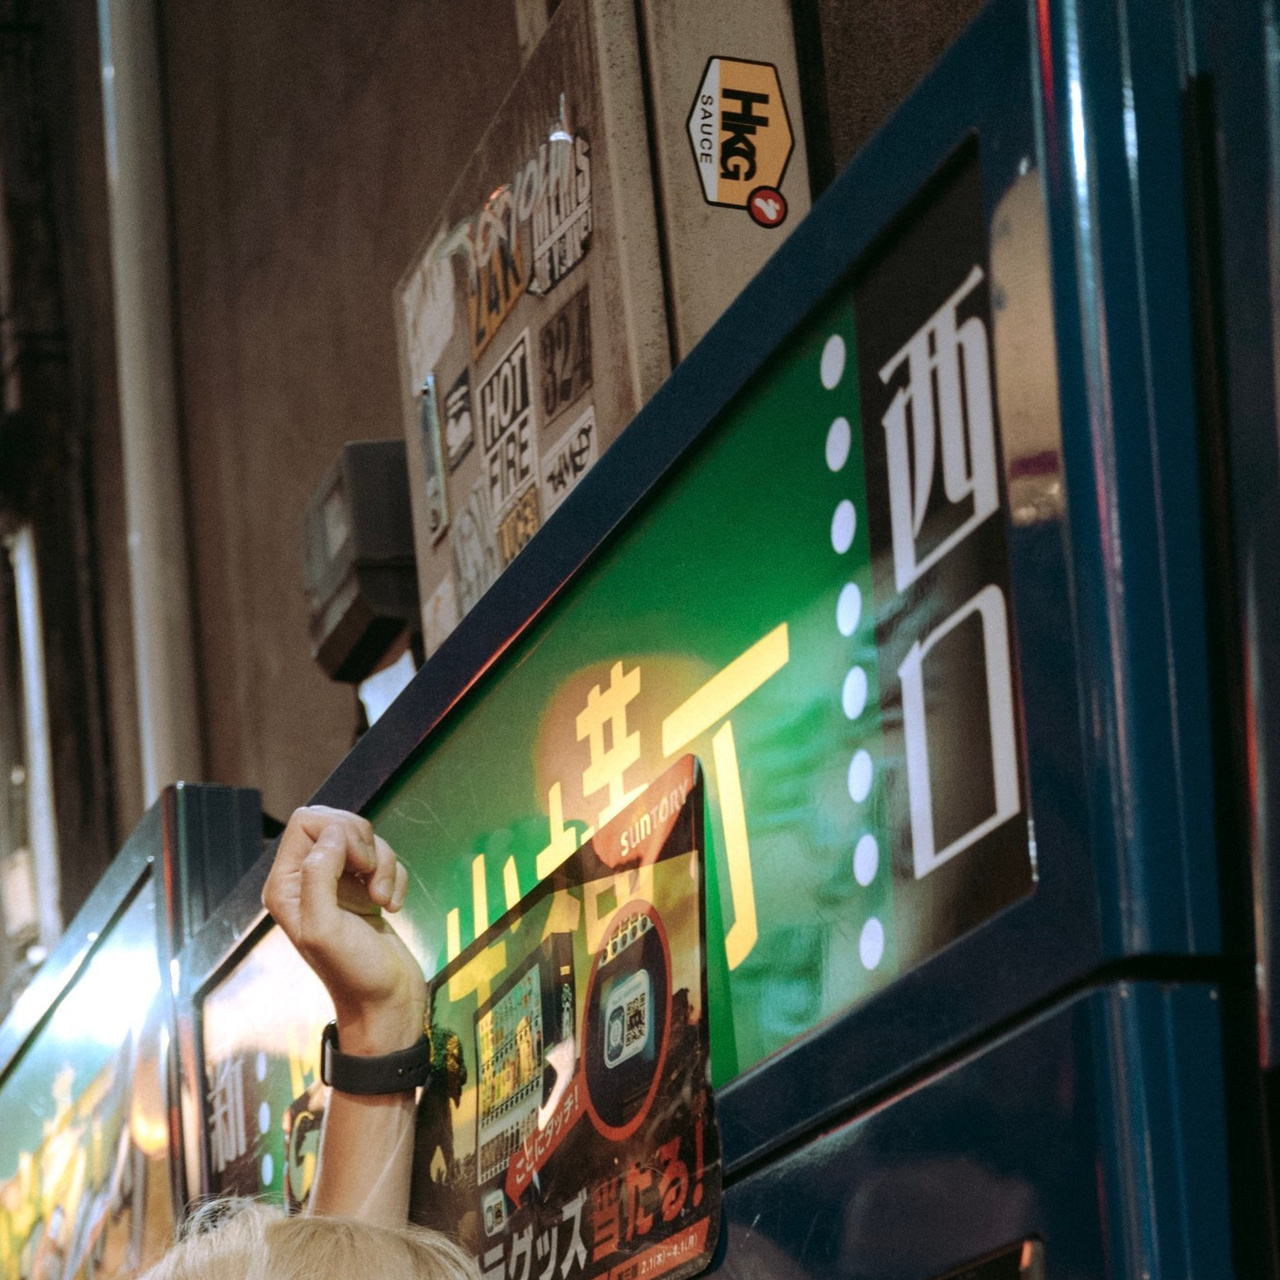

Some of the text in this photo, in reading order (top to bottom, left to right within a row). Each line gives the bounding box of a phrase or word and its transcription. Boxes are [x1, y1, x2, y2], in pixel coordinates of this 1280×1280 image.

[700, 94, 713, 164] SAUCE
[720, 88, 769, 181] HKG
[483, 344, 525, 450] HOT
[488, 416, 530, 511] FIRE
[878, 266, 1020, 880] 西口
